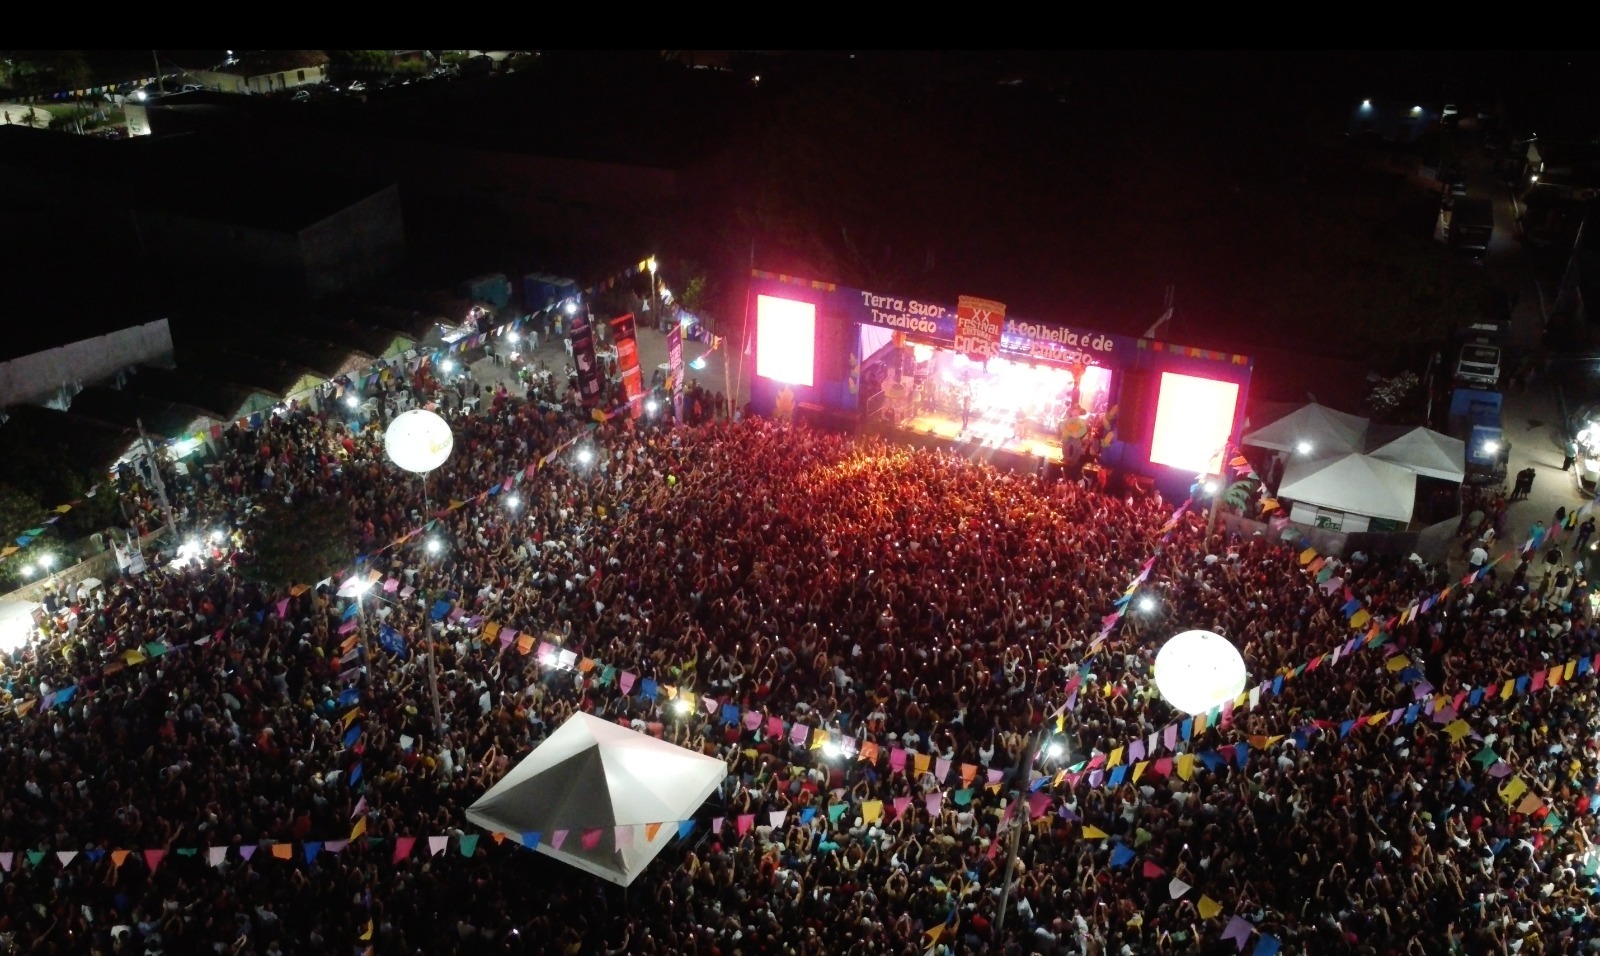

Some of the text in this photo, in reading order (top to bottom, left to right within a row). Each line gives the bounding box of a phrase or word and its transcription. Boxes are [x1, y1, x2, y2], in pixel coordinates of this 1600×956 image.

[861, 291, 906, 312] Terra,
[871, 309, 936, 333] Tradição
[971, 308, 992, 322] XX
[1007, 320, 1114, 352] A Colheita é de
